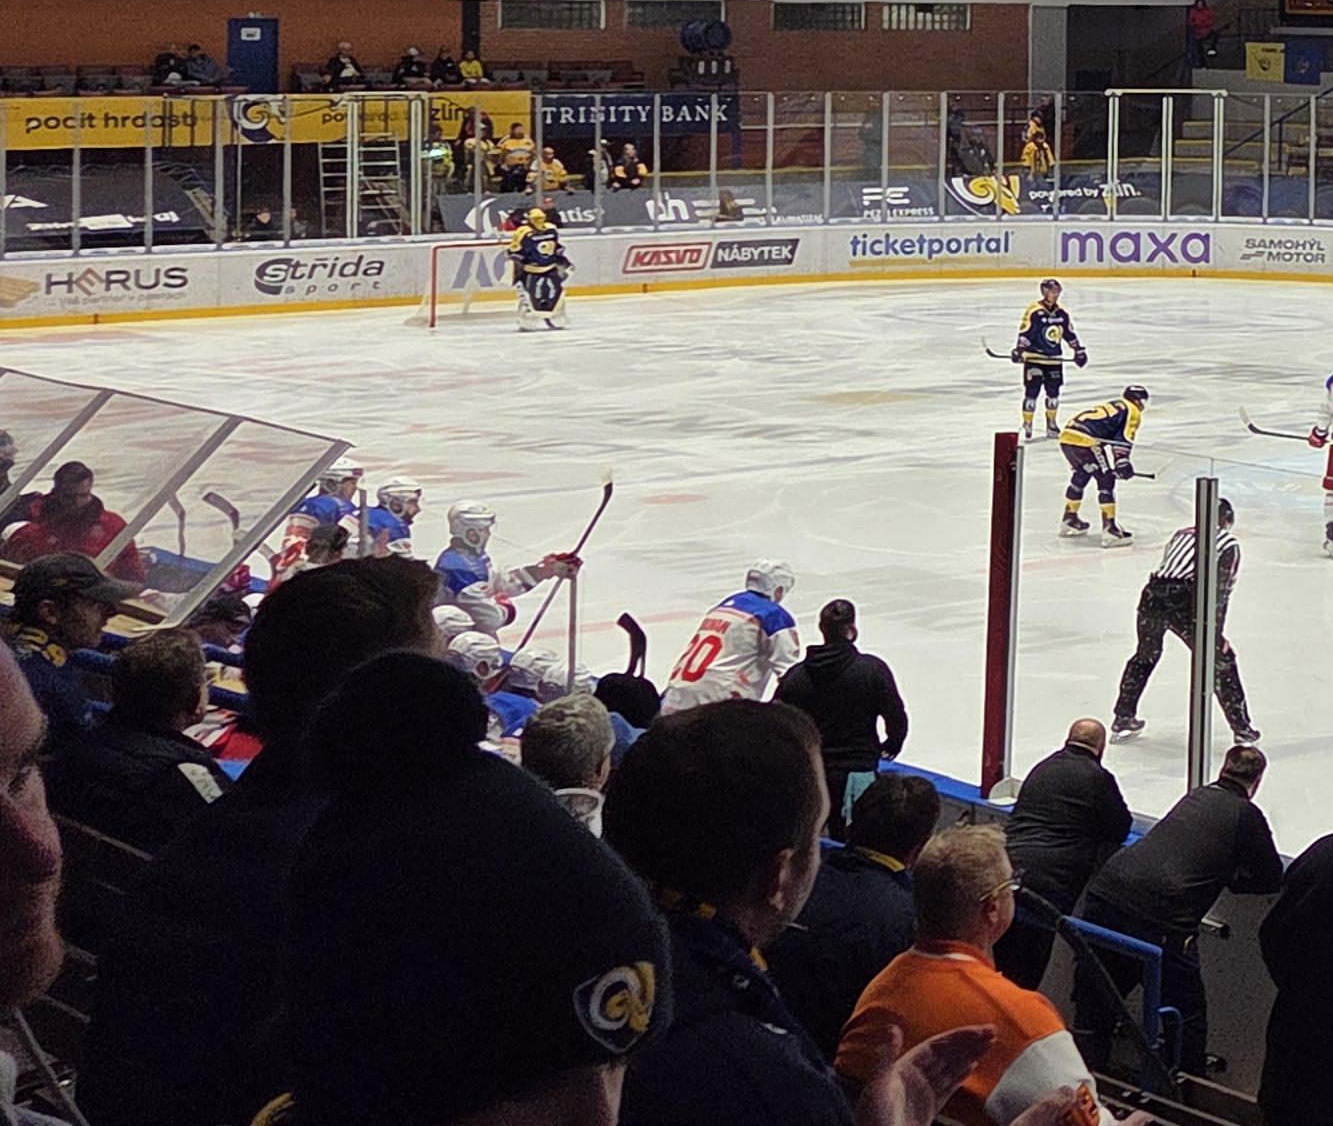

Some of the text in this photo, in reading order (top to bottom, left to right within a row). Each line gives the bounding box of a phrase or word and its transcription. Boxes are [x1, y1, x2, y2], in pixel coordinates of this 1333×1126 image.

[26, 111, 96, 134] pocit
[661, 104, 729, 124] BANK
[1083, 186, 1100, 199] by
[849, 231, 1011, 259] ticketportal
[1061, 231, 1211, 265] maxa
[1244, 236, 1326, 251] SAMOHÝL
[632, 243, 794, 268] KASVO NÁBYTEK
[1266, 250, 1326, 265] MOTOR
[285, 278, 382, 295] sport
